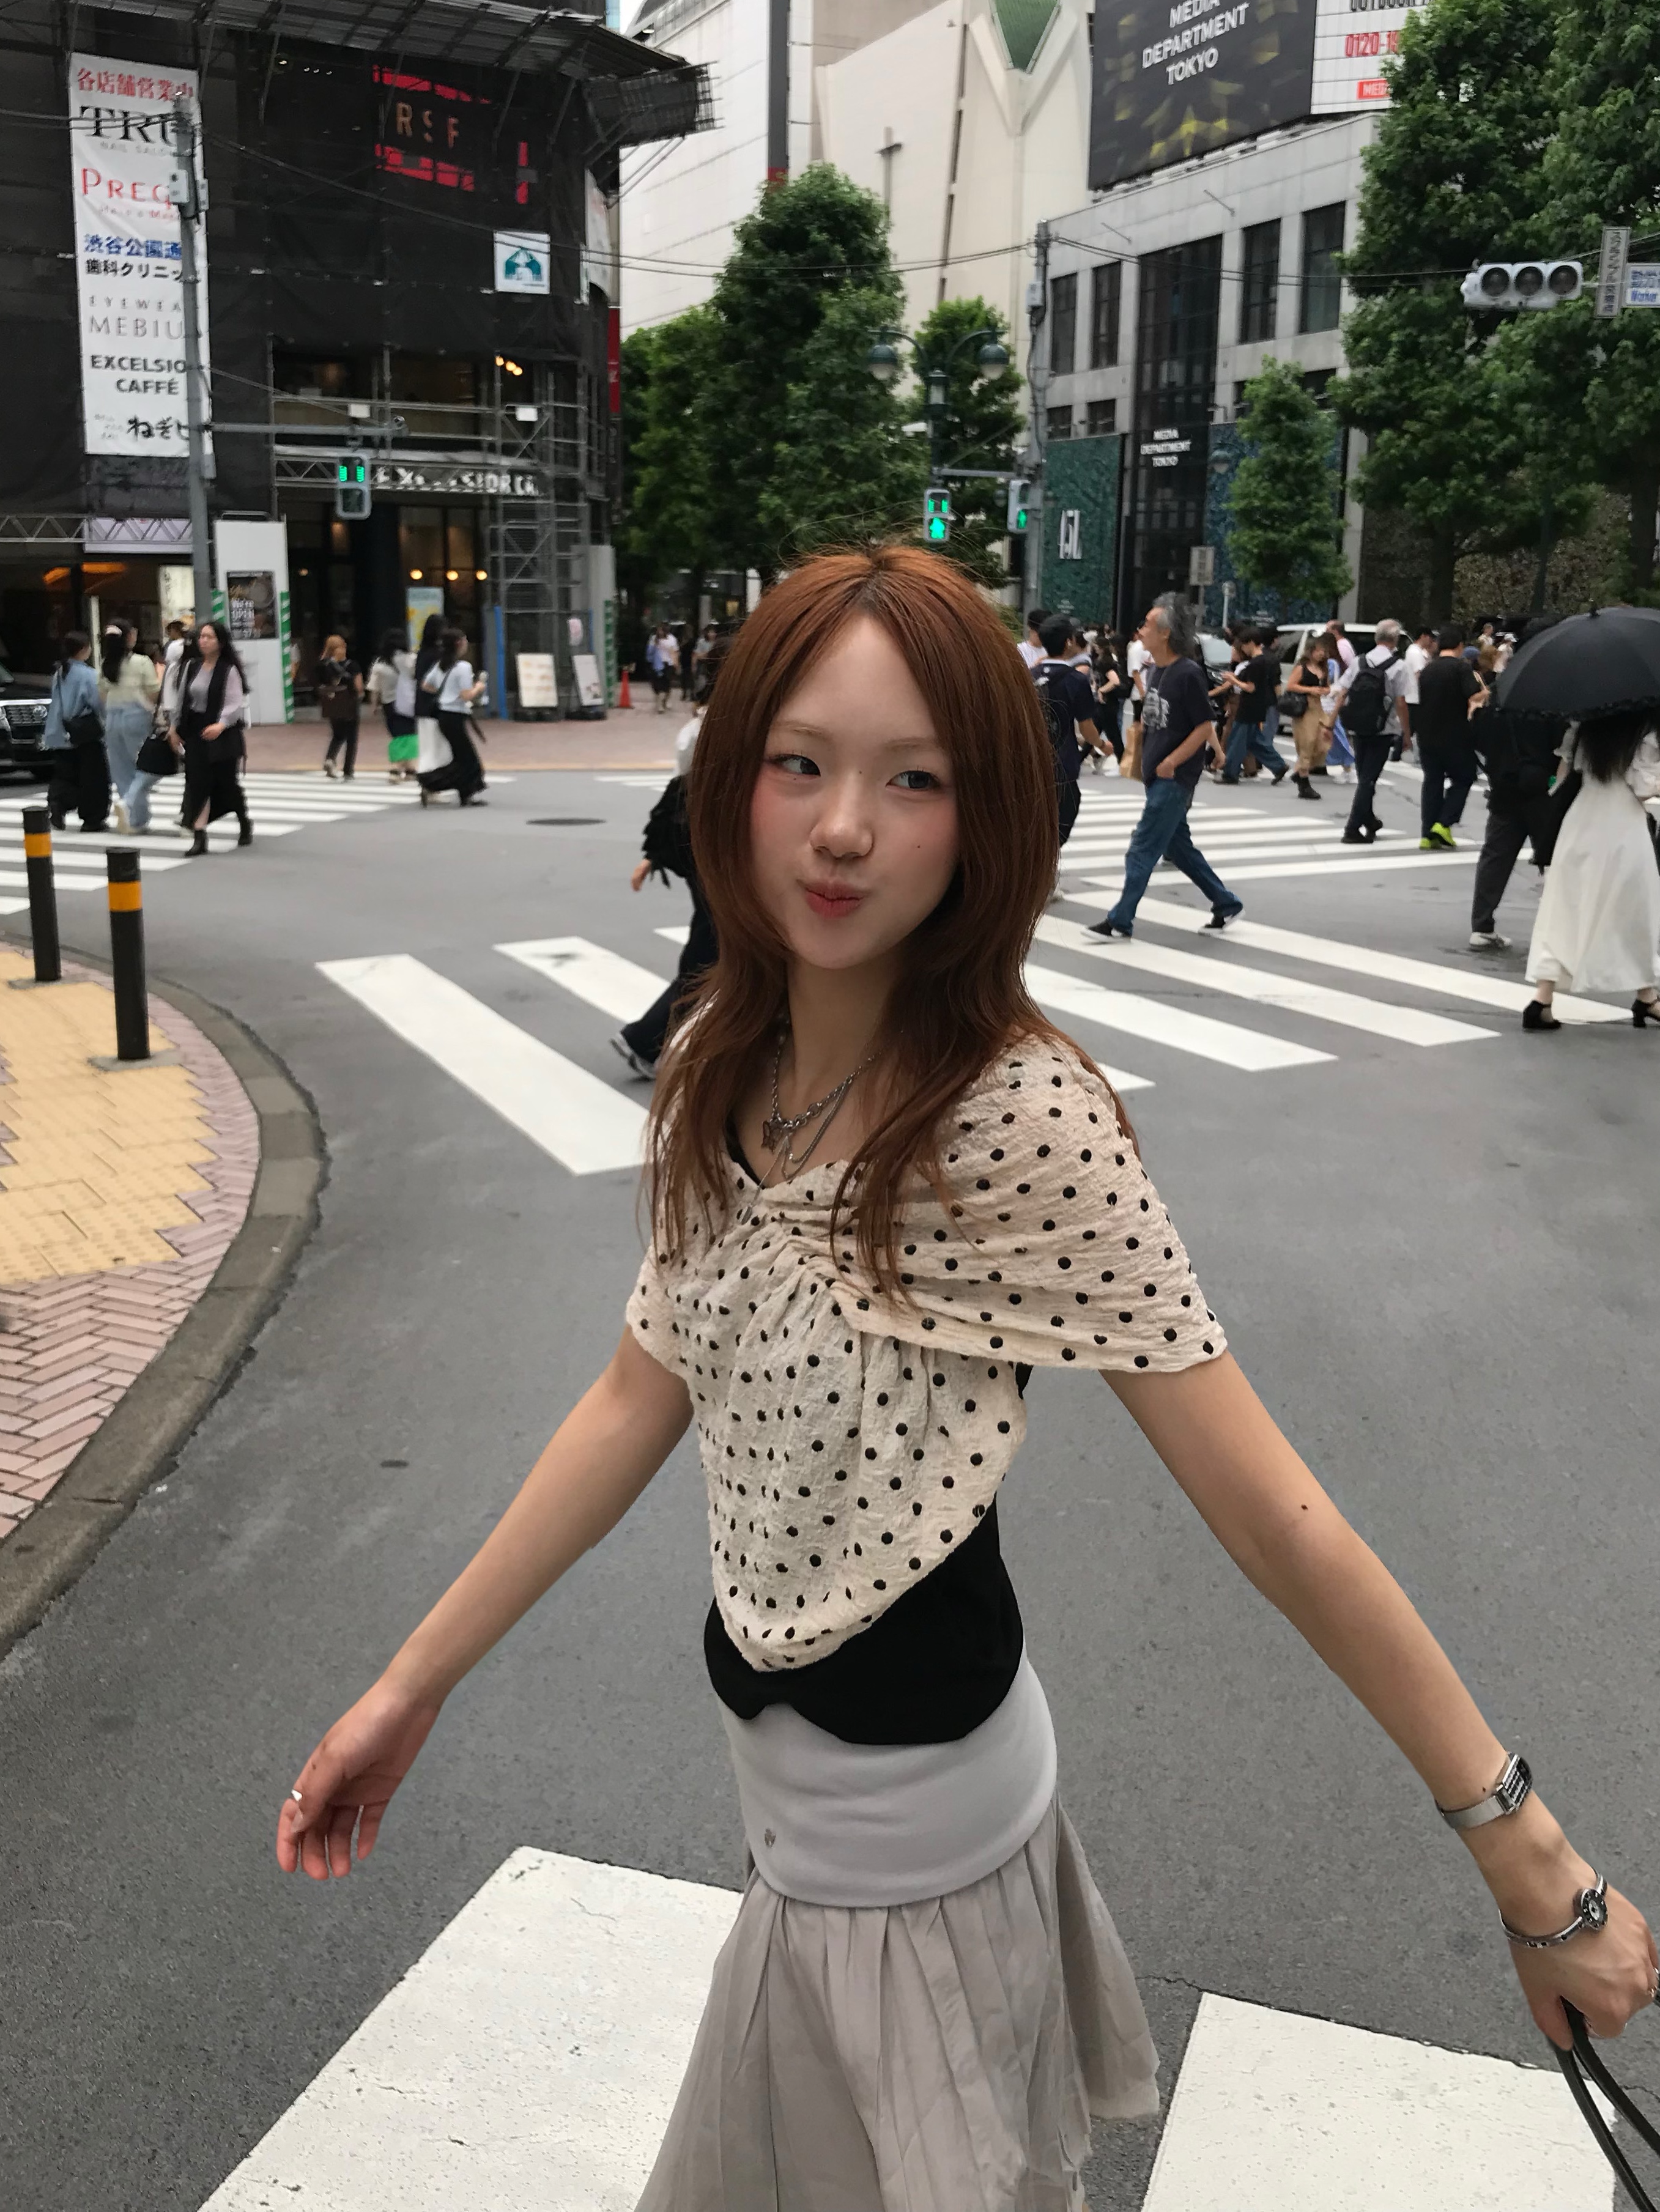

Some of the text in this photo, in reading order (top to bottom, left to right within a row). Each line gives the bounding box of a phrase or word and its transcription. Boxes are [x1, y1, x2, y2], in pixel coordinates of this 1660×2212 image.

[1142, 2, 1250, 68] DEPARTMENT
[1166, 47, 1219, 85] TOKYO
[84, 234, 182, 260] 渋谷公園通
[86, 258, 183, 281] 歯科クリニッ
[89, 295, 182, 312] EYEWEA
[89, 316, 183, 340] MEBIU
[91, 355, 186, 374] EXCELSIO
[116, 378, 179, 395] CAFFÉ
